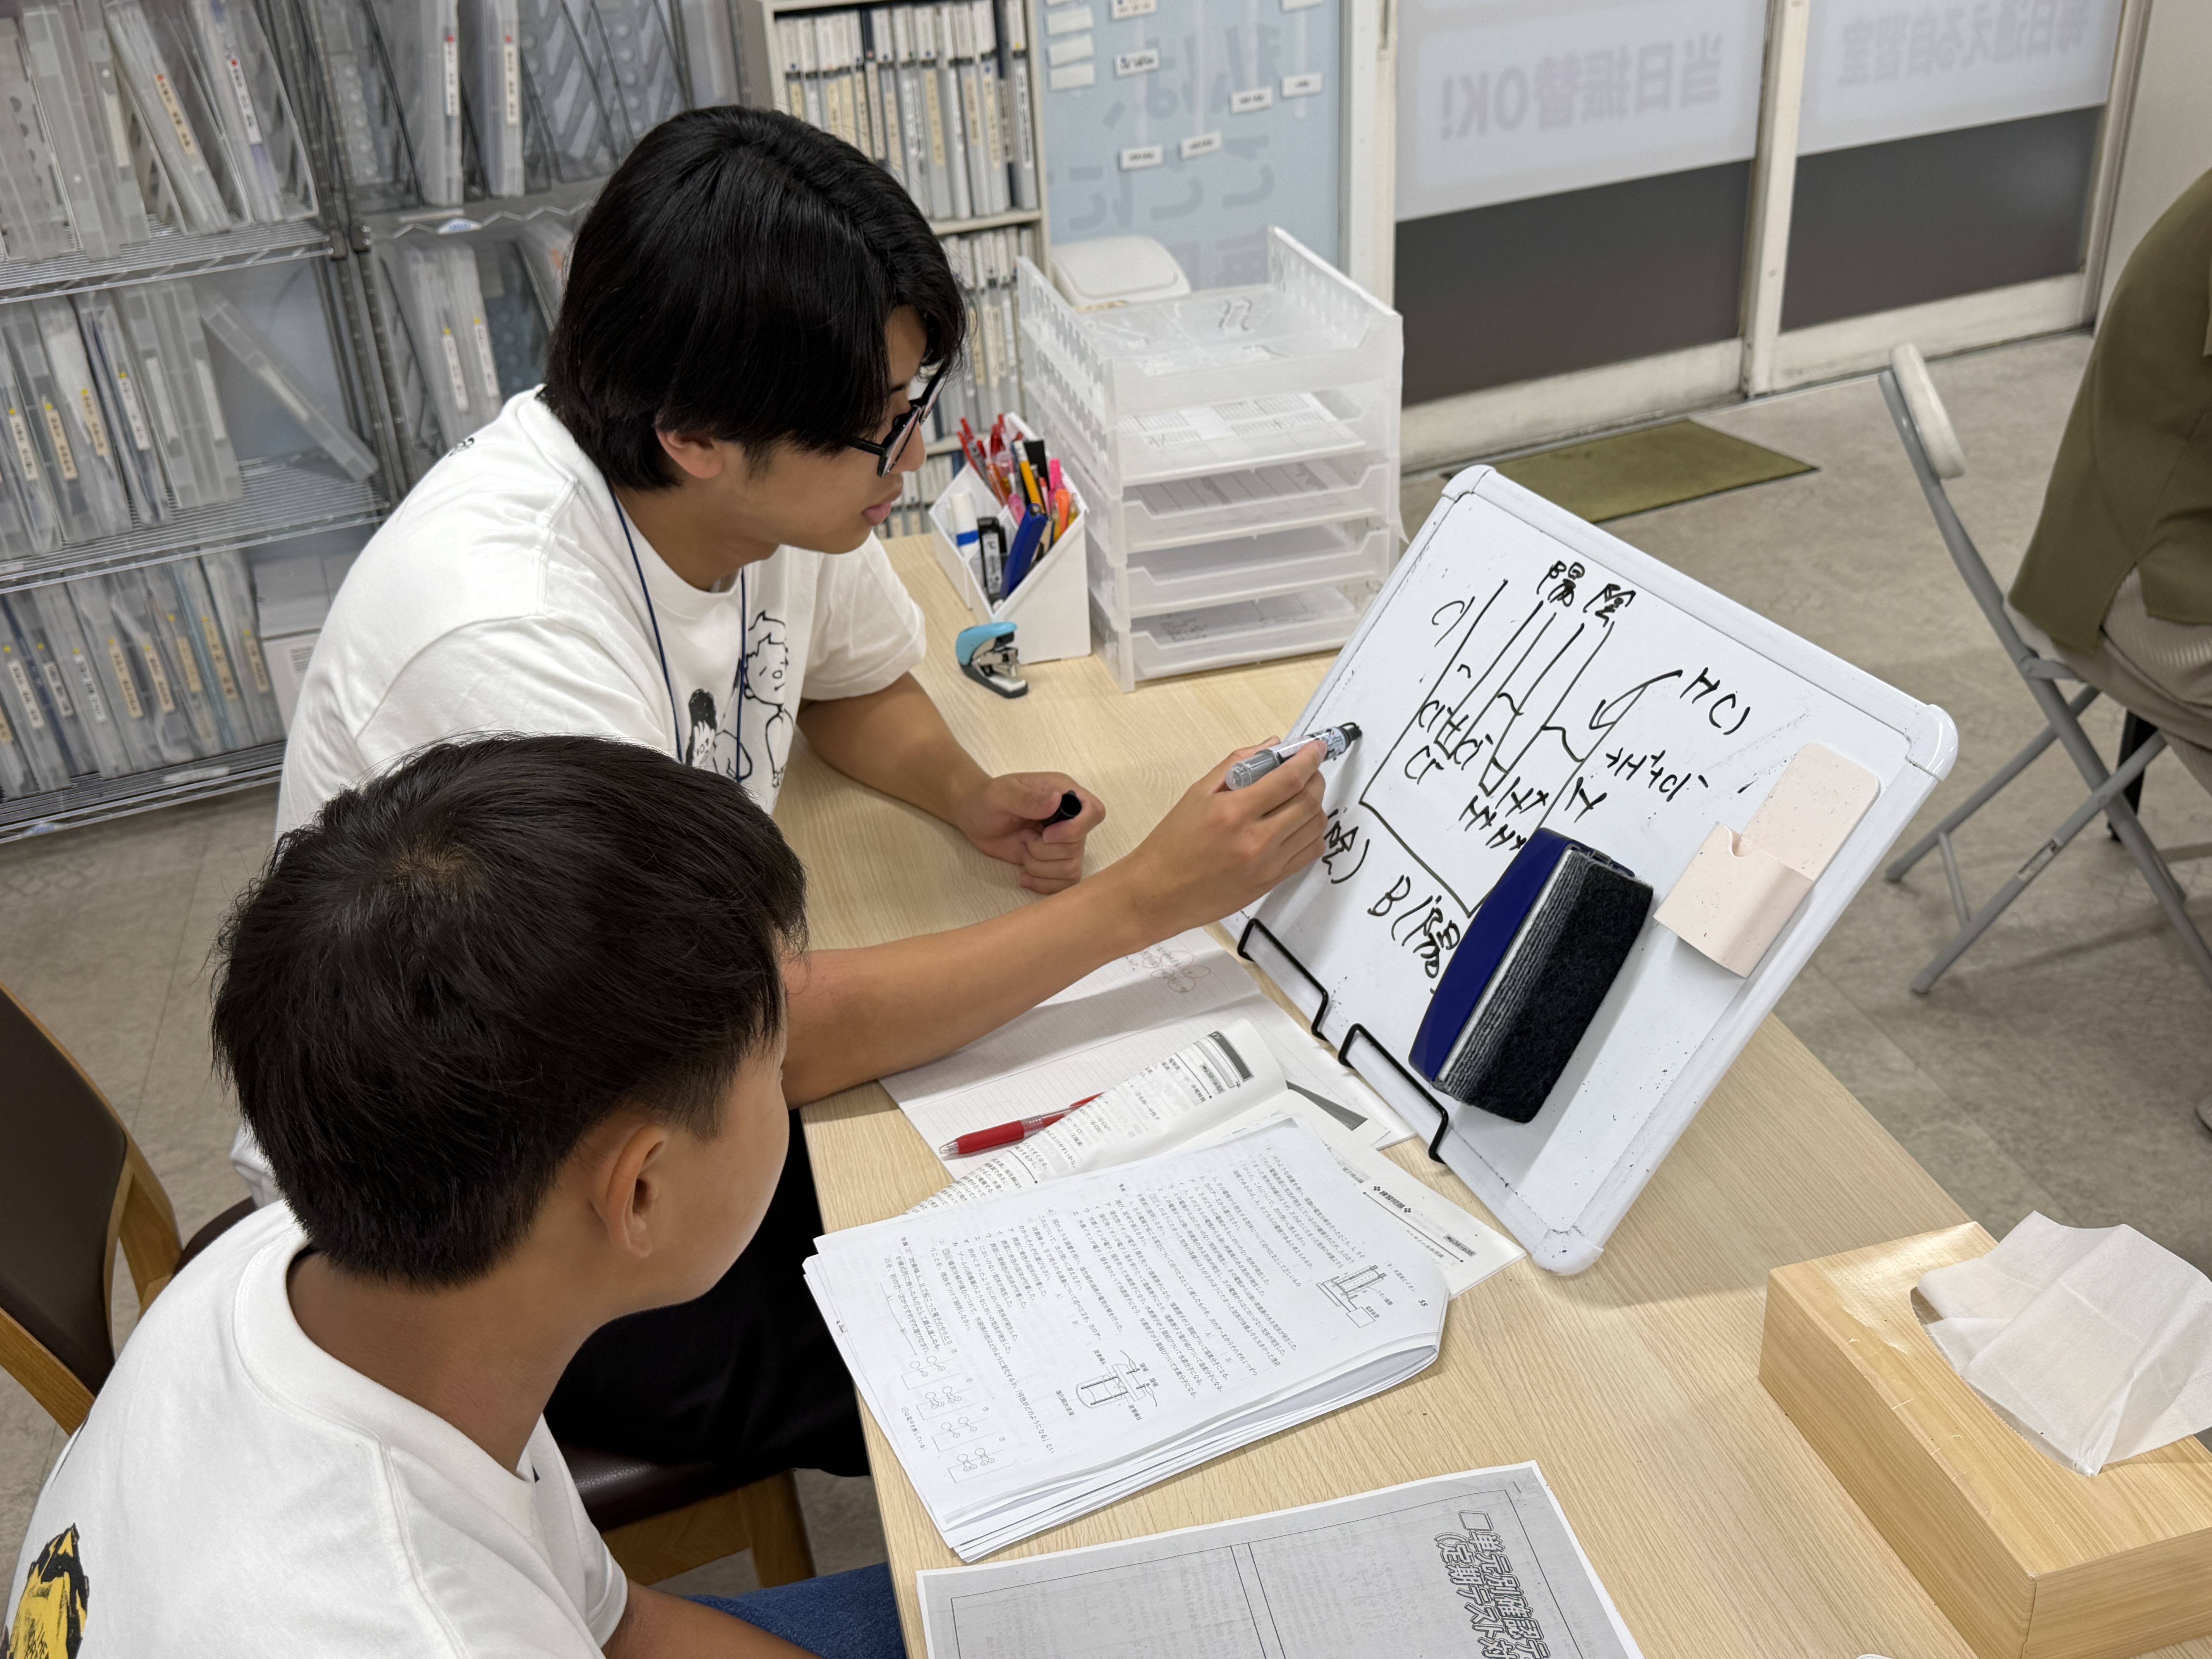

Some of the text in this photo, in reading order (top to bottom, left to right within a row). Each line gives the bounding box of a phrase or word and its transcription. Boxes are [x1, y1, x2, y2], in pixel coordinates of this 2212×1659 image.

[1680, 667, 1751, 735] HCl
[1379, 1188, 1406, 1211] 練習問題
